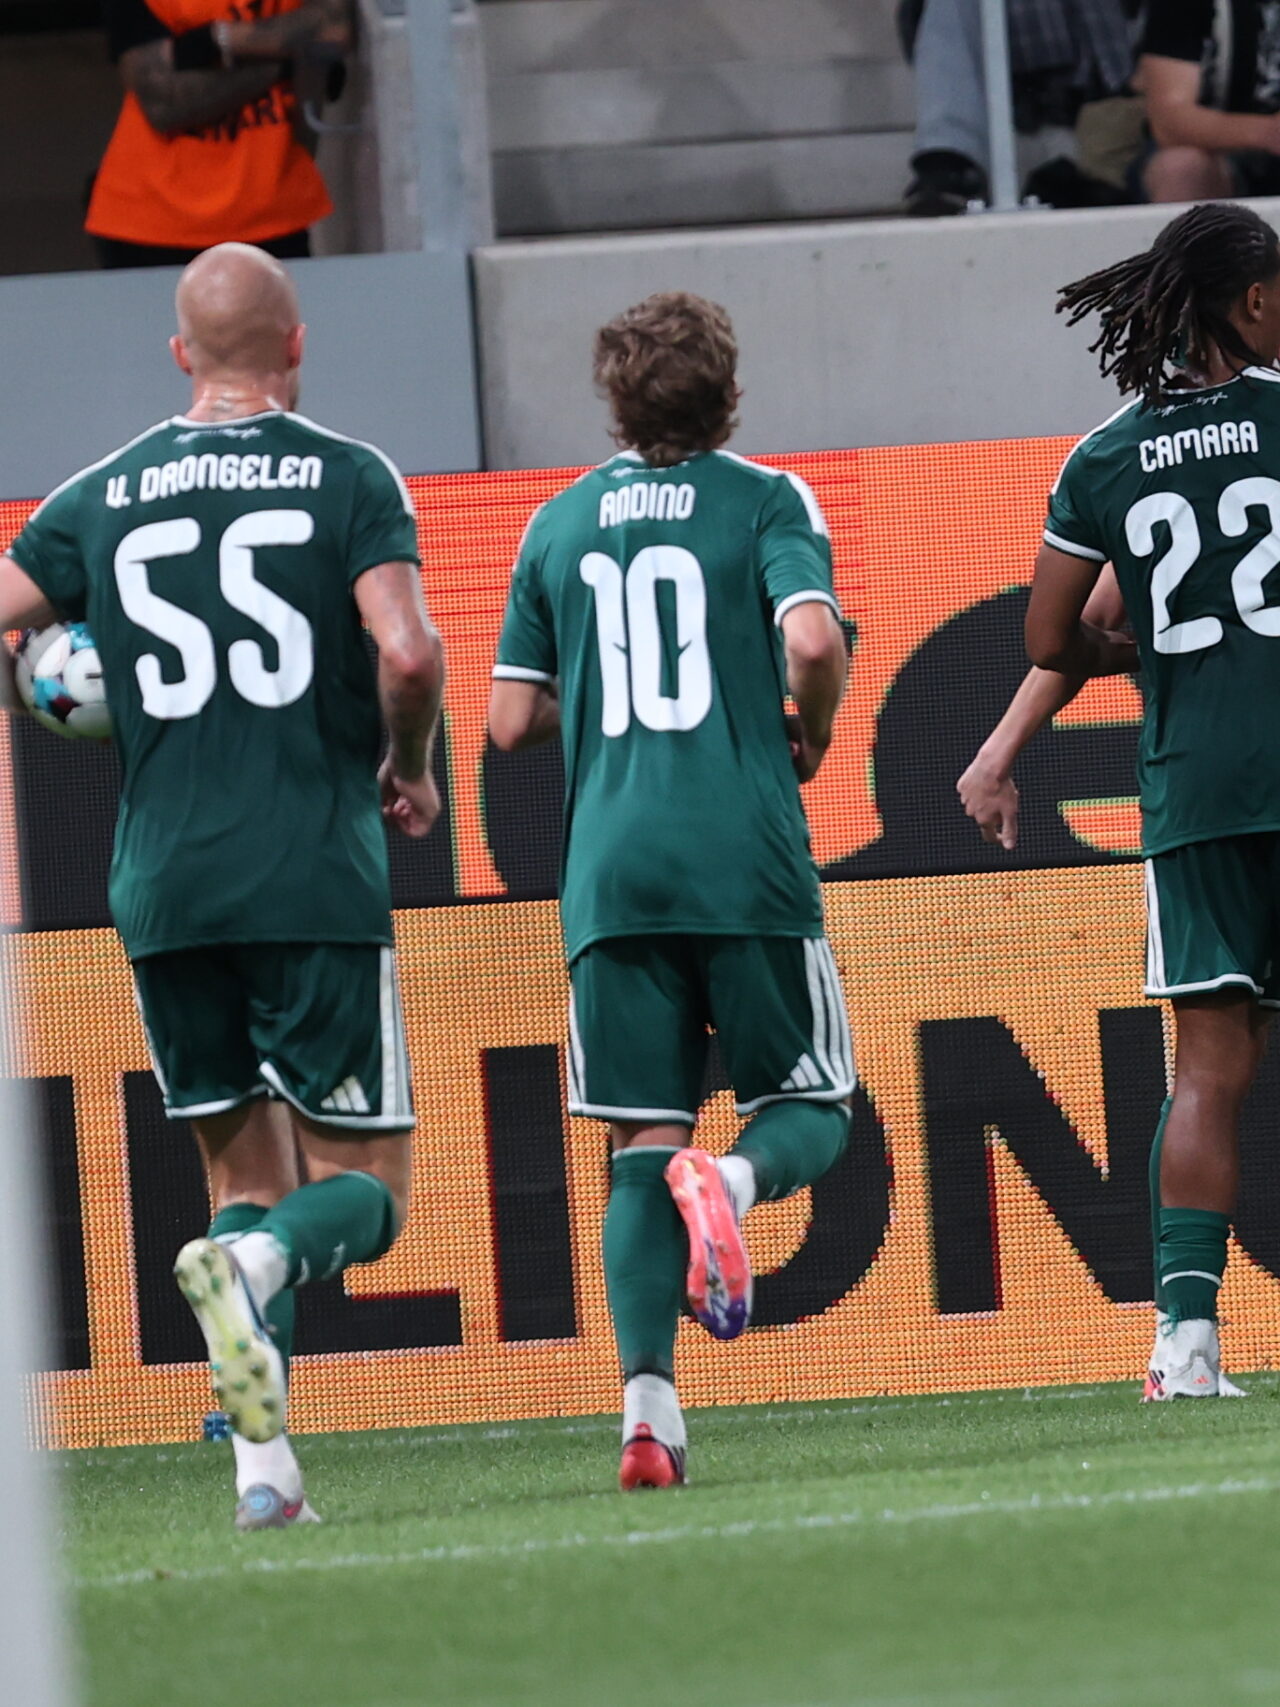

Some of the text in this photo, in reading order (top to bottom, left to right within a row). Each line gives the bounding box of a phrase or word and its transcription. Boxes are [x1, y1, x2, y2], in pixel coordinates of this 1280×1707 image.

[1139, 420, 1259, 473] CAMARA
[139, 453, 323, 503] DRONGELEN
[599, 482, 696, 529] ANDINO
[114, 509, 314, 720] 55
[579, 545, 712, 738] 10
